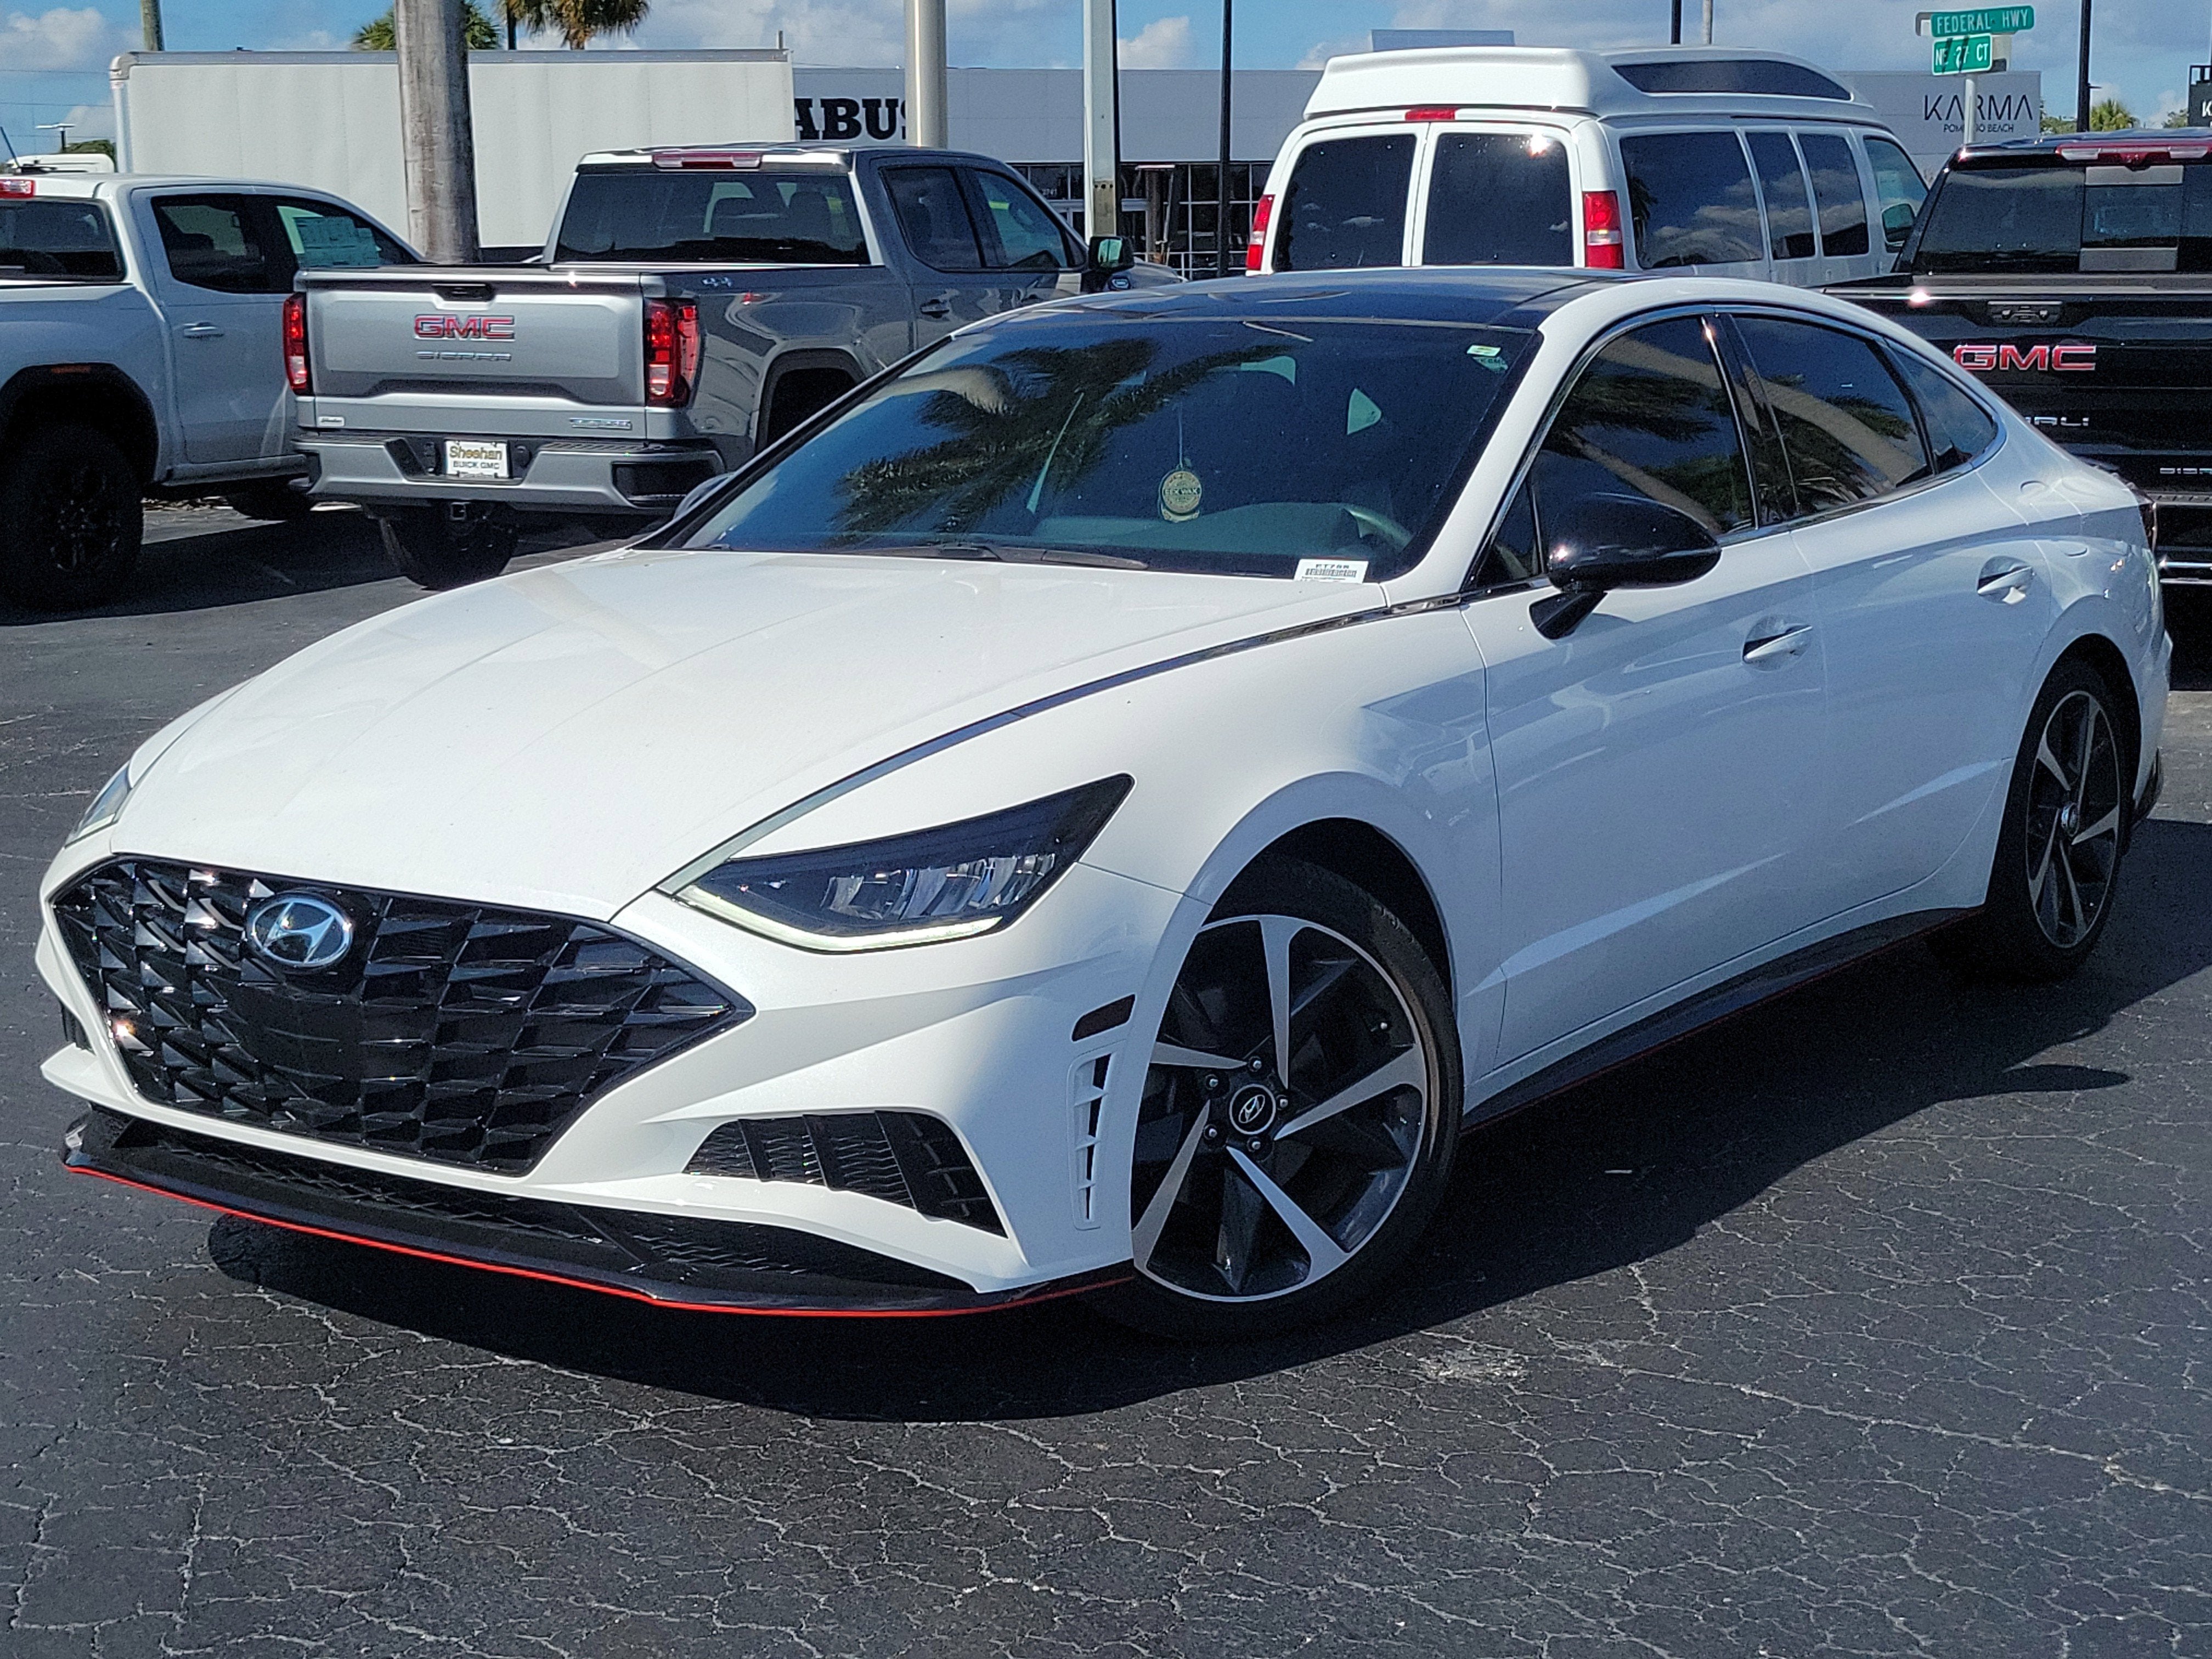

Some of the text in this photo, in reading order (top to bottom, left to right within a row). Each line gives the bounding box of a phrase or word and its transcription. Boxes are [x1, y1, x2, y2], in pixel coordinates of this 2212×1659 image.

[1937, 9, 2028, 34] FEDERAL HWY
[1935, 48, 1949, 66] NE
[1976, 43, 1989, 61] CT
[794, 98, 906, 140] ABU
[1925, 94, 2033, 120] KARMA
[1988, 123, 2014, 133] BEACH
[414, 314, 515, 342] GMC
[416, 351, 512, 362] SIERRA
[1954, 344, 2097, 371] GMC
[450, 446, 502, 460] Sheehan
